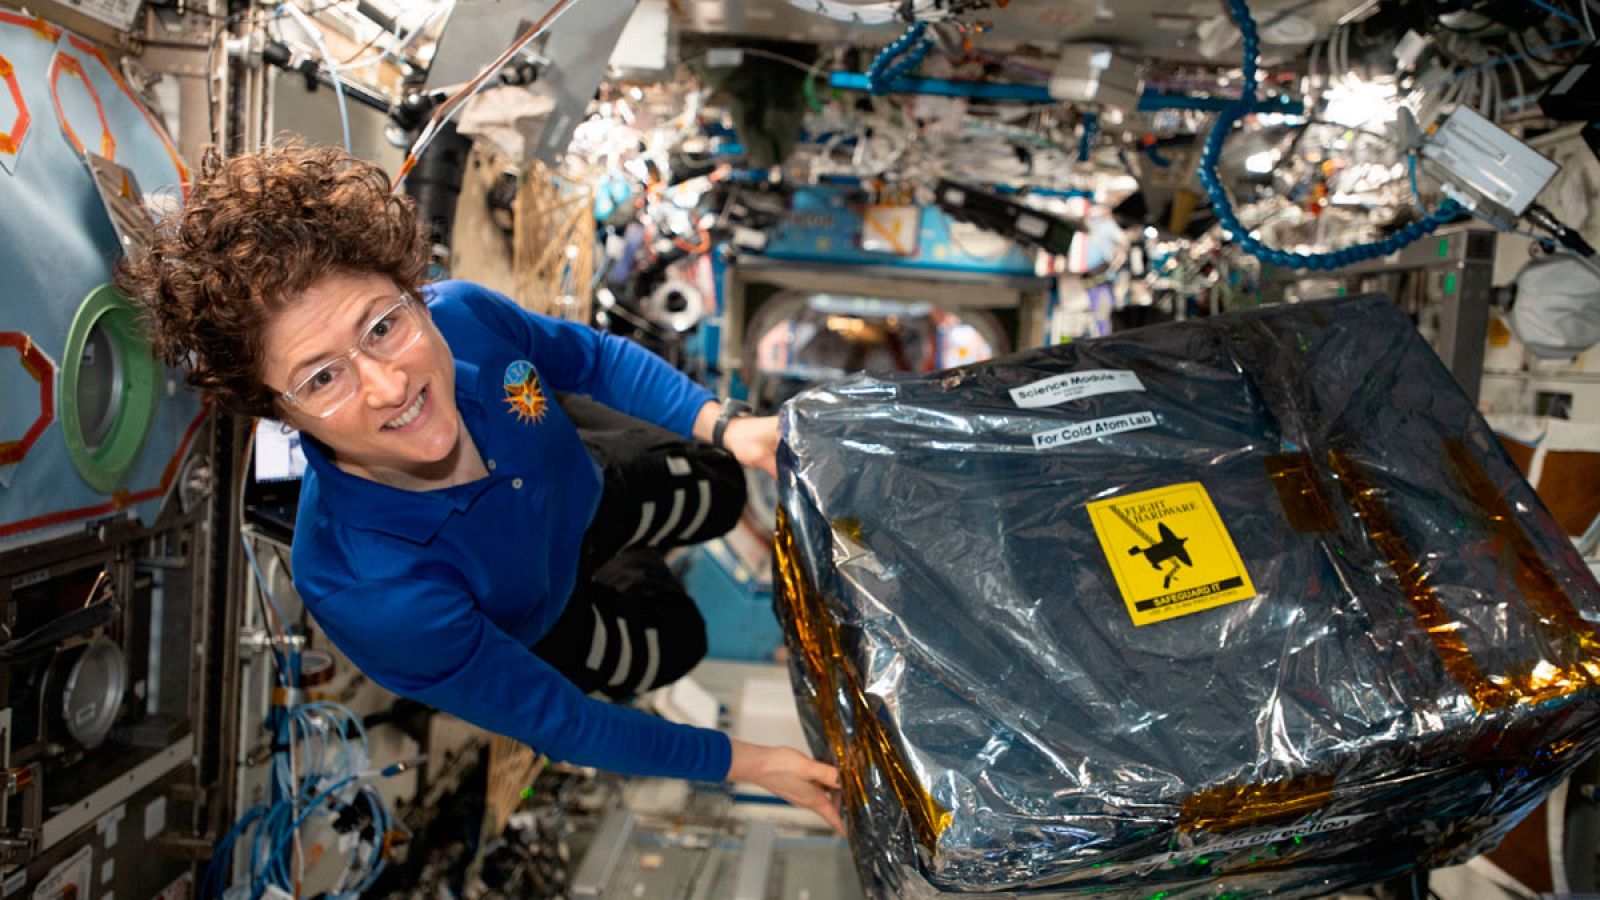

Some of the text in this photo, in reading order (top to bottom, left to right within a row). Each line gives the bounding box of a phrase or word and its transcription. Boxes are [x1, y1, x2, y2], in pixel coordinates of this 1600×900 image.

[1018, 380, 1068, 399] Science
[1071, 374, 1115, 385] Module
[1037, 415, 1151, 445] For Cold Atom Lab
[1124, 501, 1165, 517] FLIGHT
[1134, 502, 1198, 523] HARDWARE
[1153, 582, 1221, 607] SAFEGUARD IT
[1250, 819, 1349, 844] Direction
